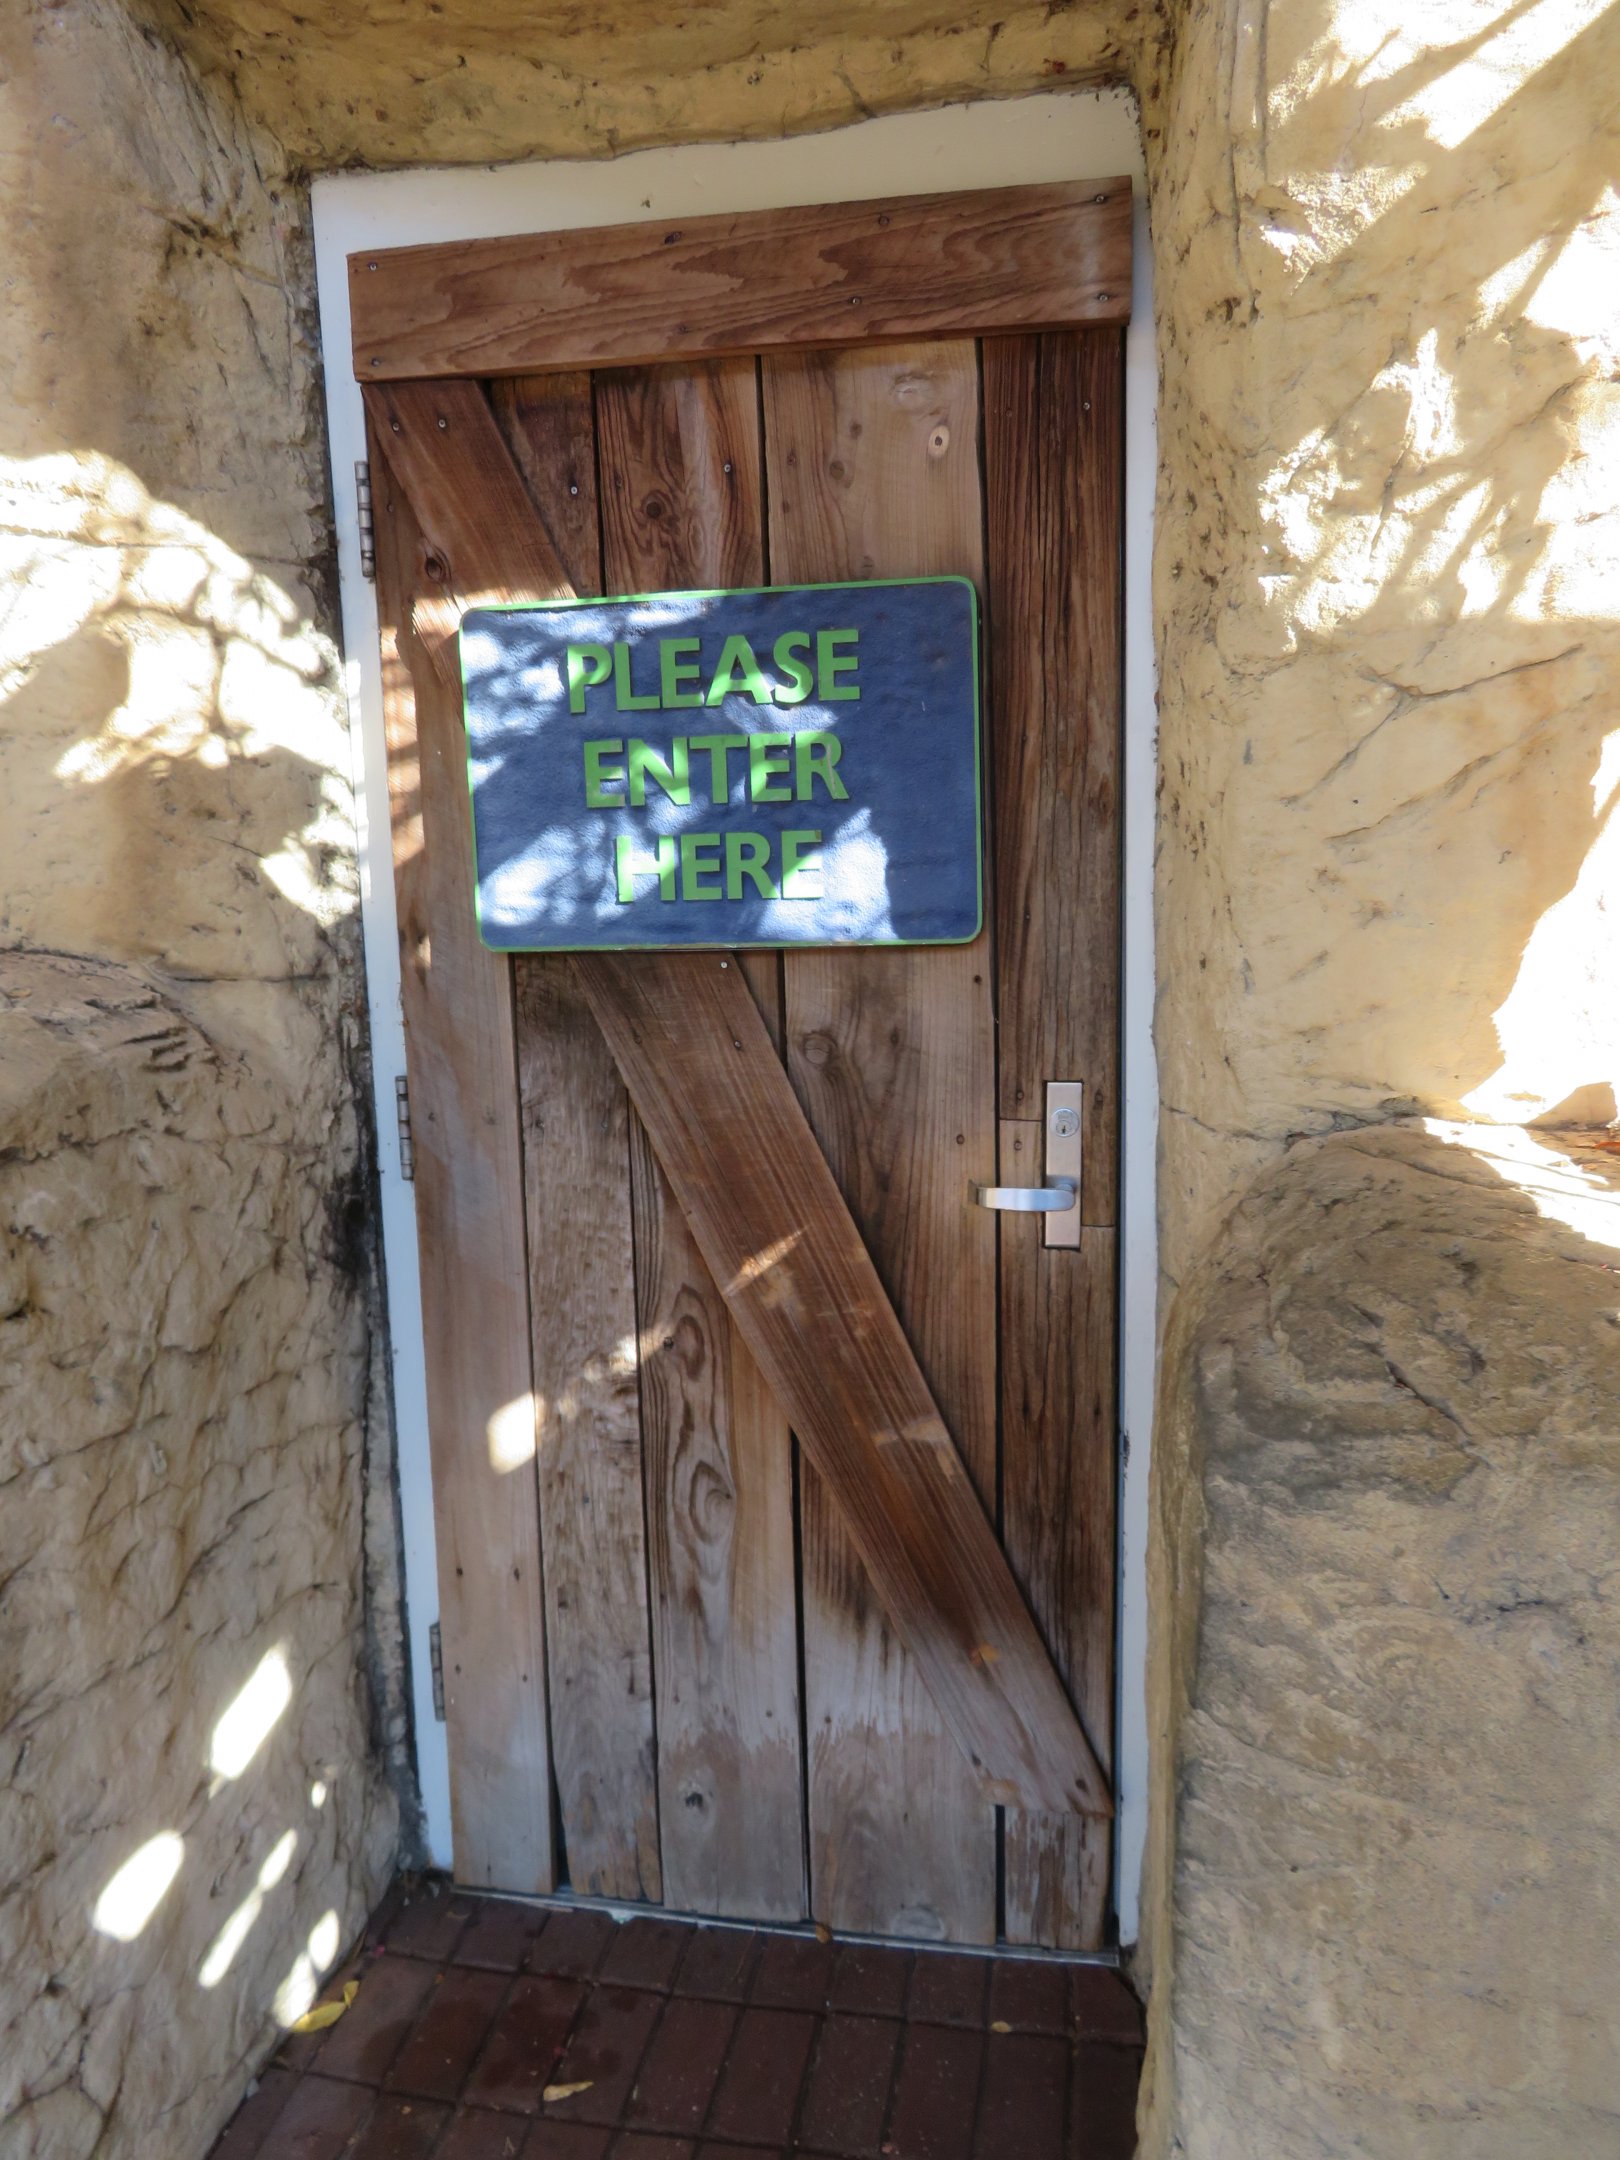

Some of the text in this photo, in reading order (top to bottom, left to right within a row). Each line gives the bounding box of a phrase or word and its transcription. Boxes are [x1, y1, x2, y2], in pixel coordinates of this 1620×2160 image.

[566, 628, 861, 714] PLEASE
[583, 730, 849, 808] ENTER
[615, 830, 823, 902] HERE
